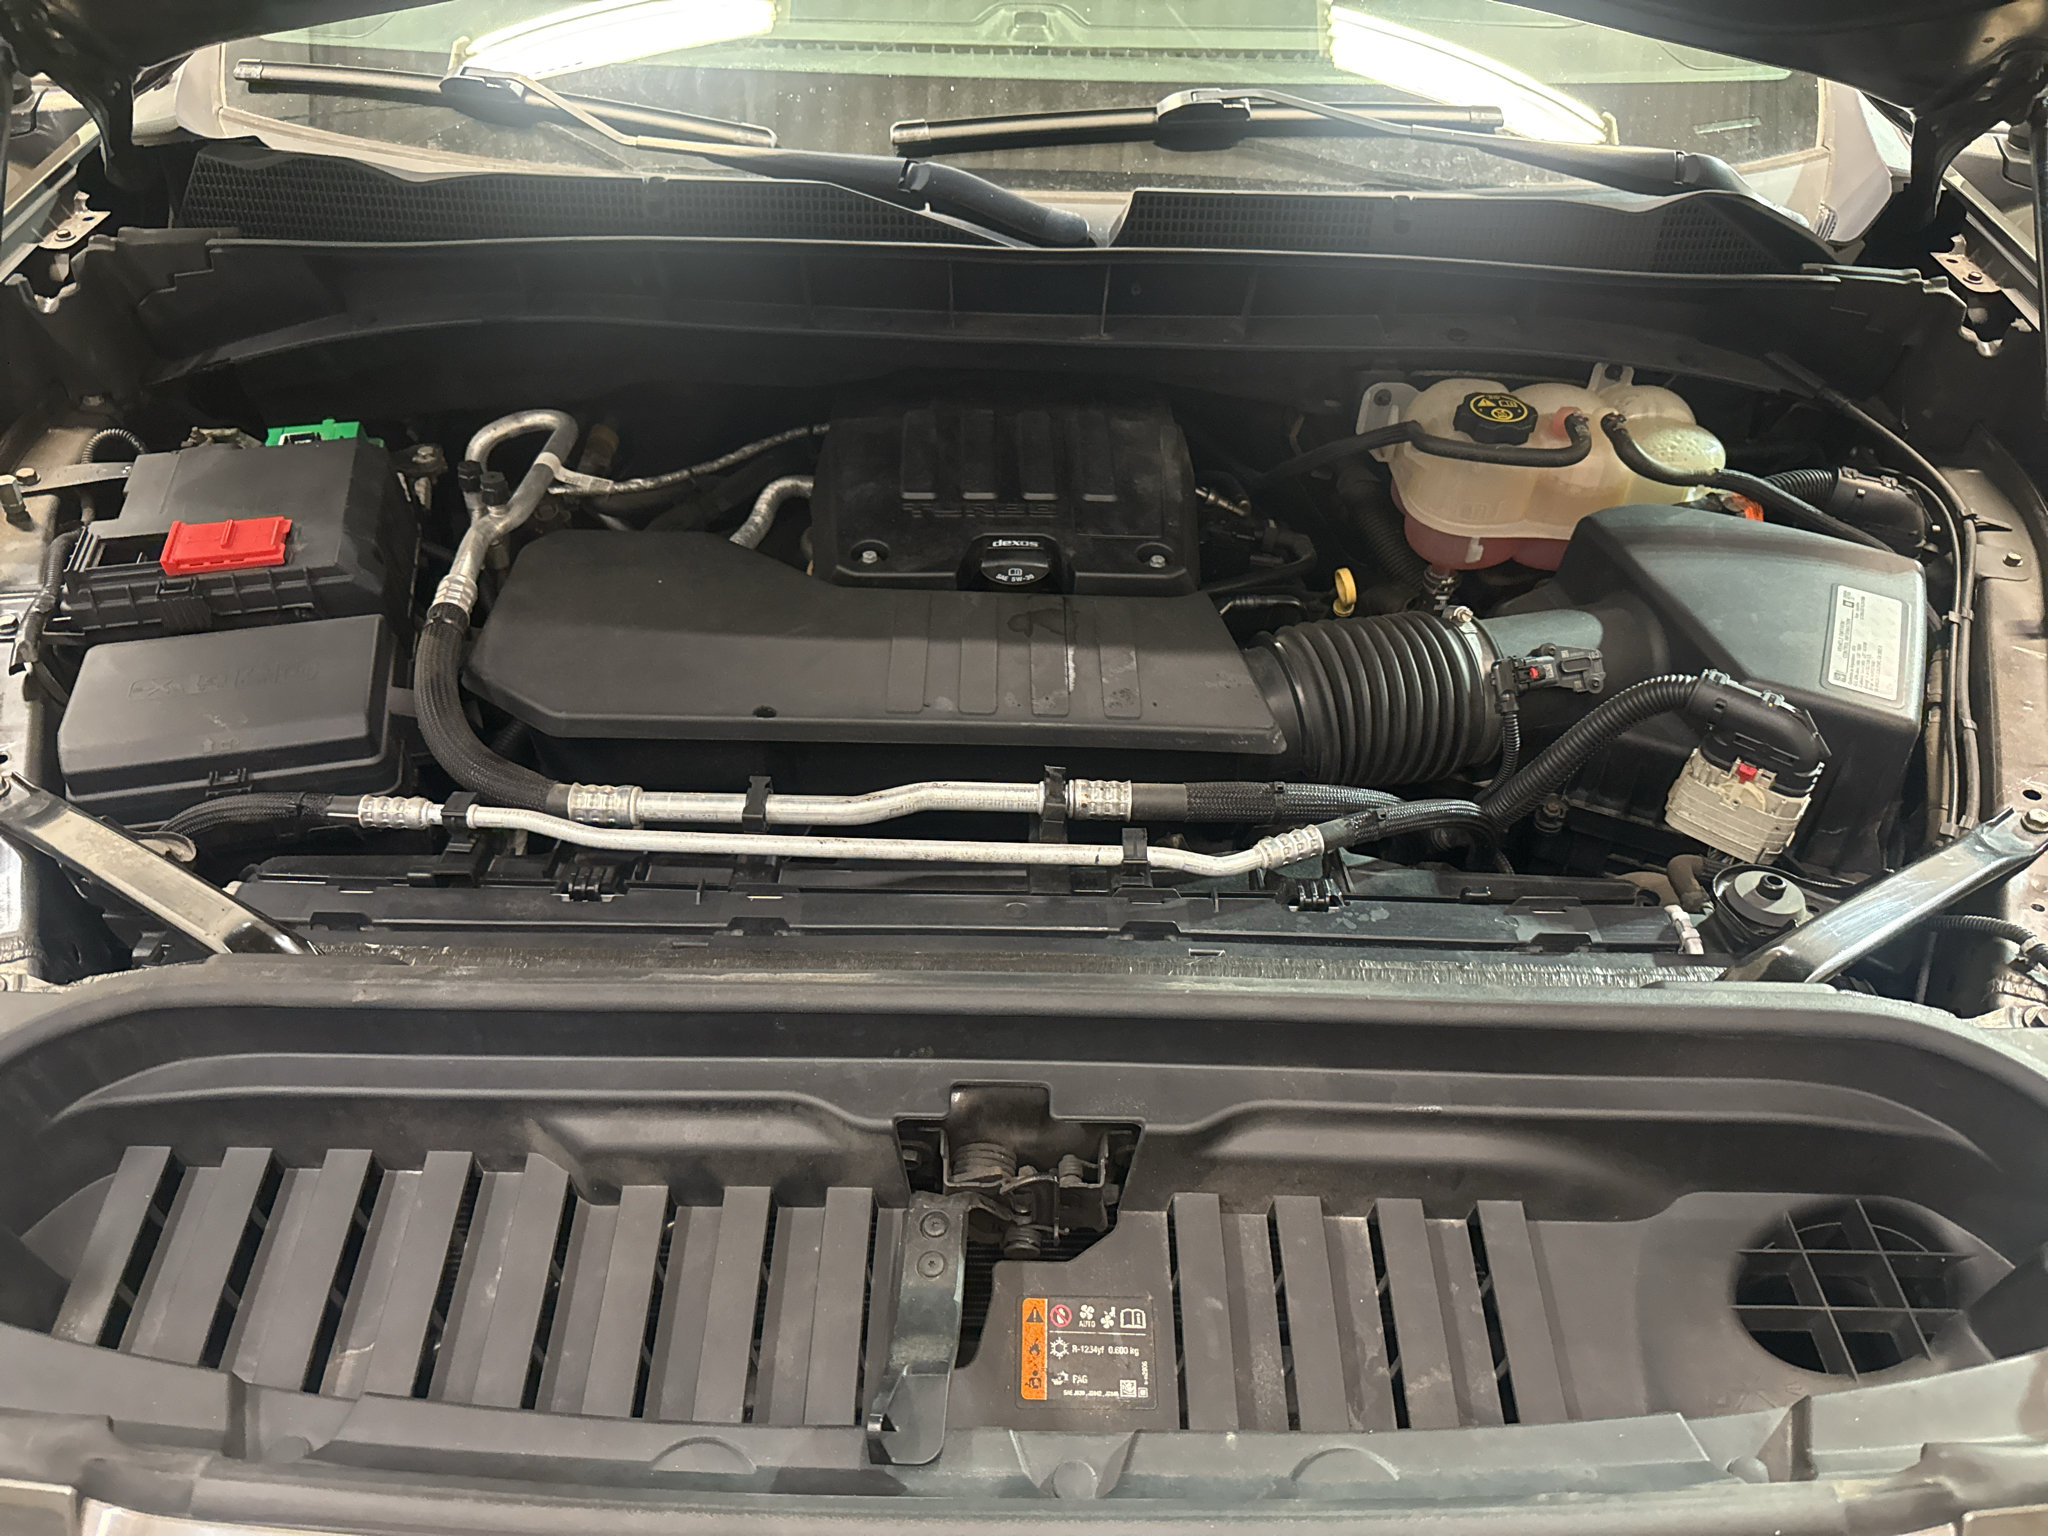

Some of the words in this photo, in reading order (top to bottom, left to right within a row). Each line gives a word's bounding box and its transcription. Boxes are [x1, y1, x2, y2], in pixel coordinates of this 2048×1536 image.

[902, 502, 1058, 519] TURBO
[992, 539, 1039, 548] dexos
[995, 573, 1009, 582] SAE
[1079, 1320, 1096, 1328] AUTO
[1071, 1345, 1105, 1356] R-1234yf
[1129, 1346, 1140, 1357] kg
[1072, 1374, 1089, 1384] PAG
